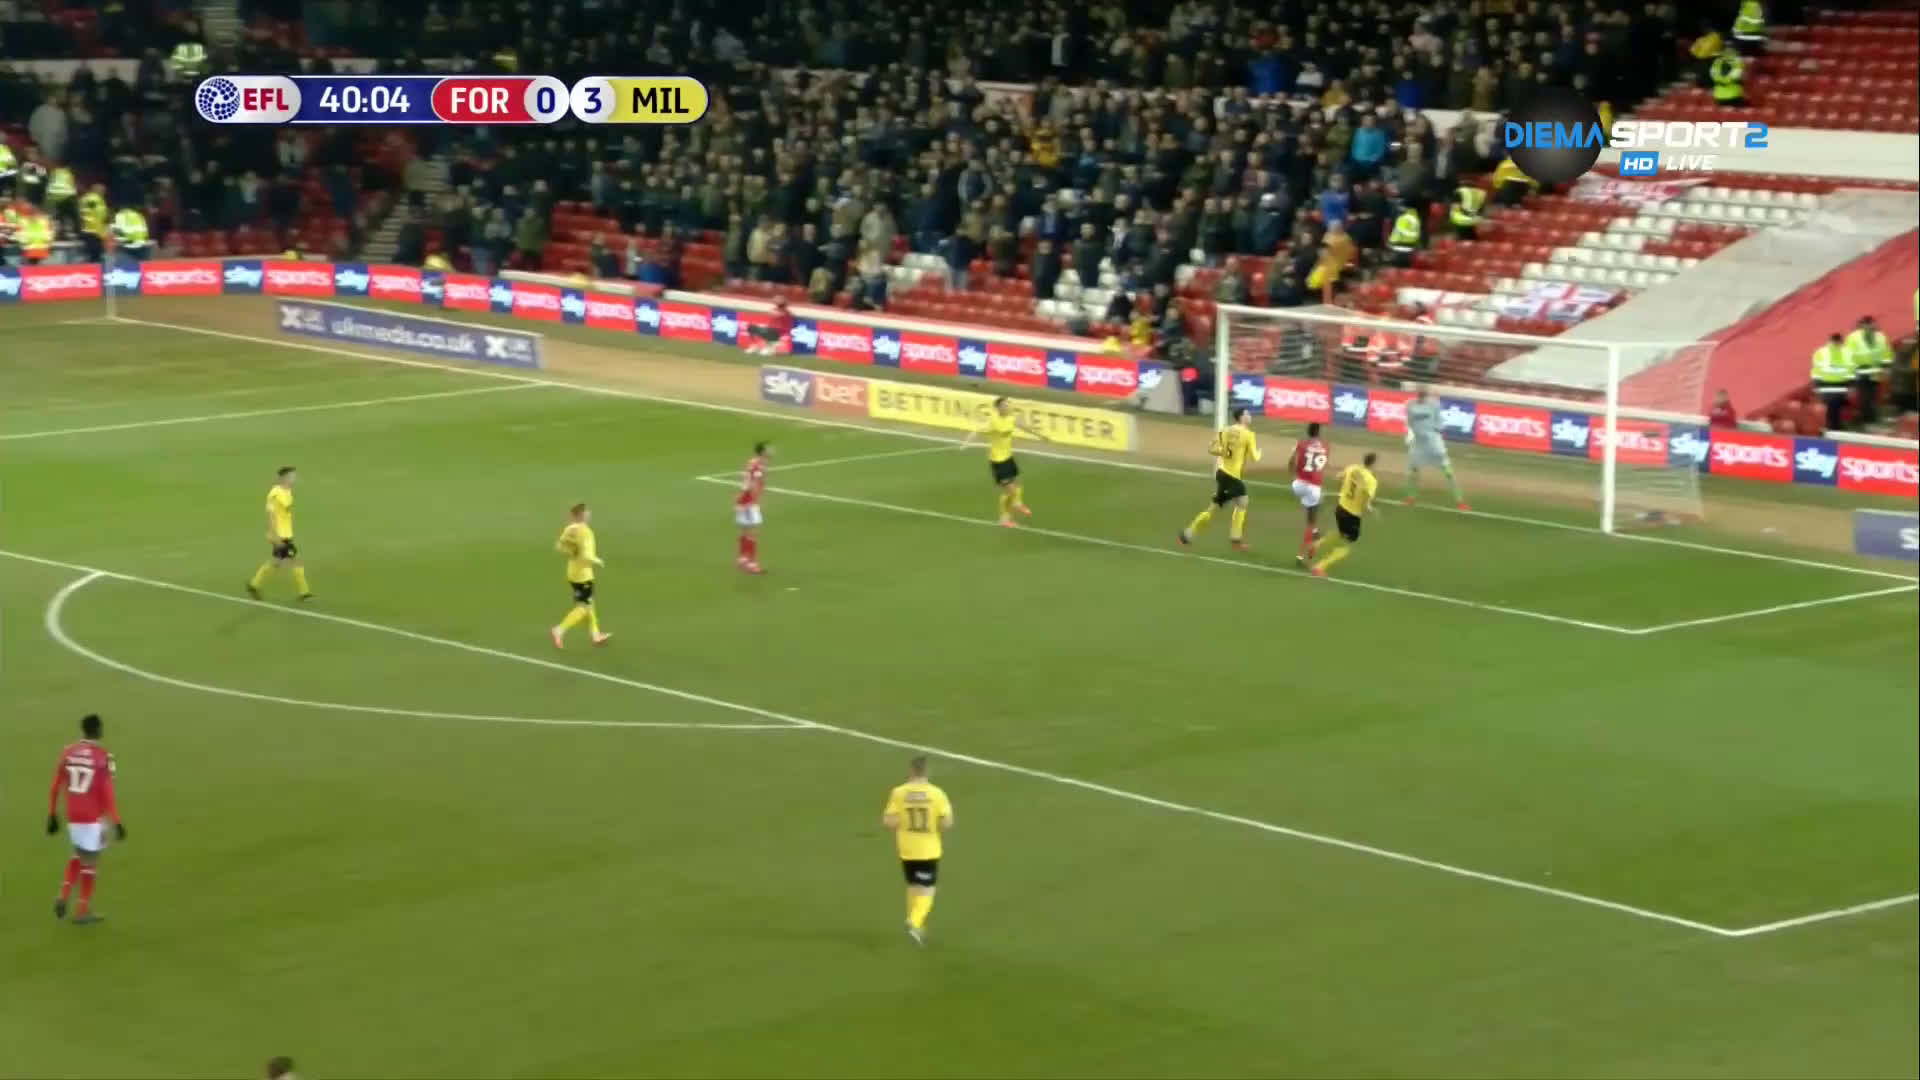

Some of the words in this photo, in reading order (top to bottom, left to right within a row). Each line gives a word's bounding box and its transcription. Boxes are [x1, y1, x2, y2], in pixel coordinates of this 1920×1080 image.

[791, 324, 818, 348] sky
[818, 331, 871, 353] sports
[873, 335, 901, 360] sky
[903, 342, 956, 363] sports
[959, 345, 987, 371] sky
[989, 353, 1044, 375] sports
[1047, 357, 1077, 383] sky
[1079, 365, 1136, 387] sports
[763, 371, 810, 402] sky
[815, 377, 865, 407] bet
[878, 388, 994, 424] BETTING
[1232, 378, 1266, 407] sky
[1267, 386, 1330, 411] sports
[1334, 390, 1369, 420] sky
[1478, 413, 1546, 439] sports
[1552, 418, 1590, 448] sky
[1304, 451, 1328, 472] 19
[1669, 432, 1710, 463] sky
[1713, 442, 1789, 469] sports
[1795, 447, 1838, 478] sky
[65, 765, 95, 793] 17
[905, 807, 930, 832] 11
